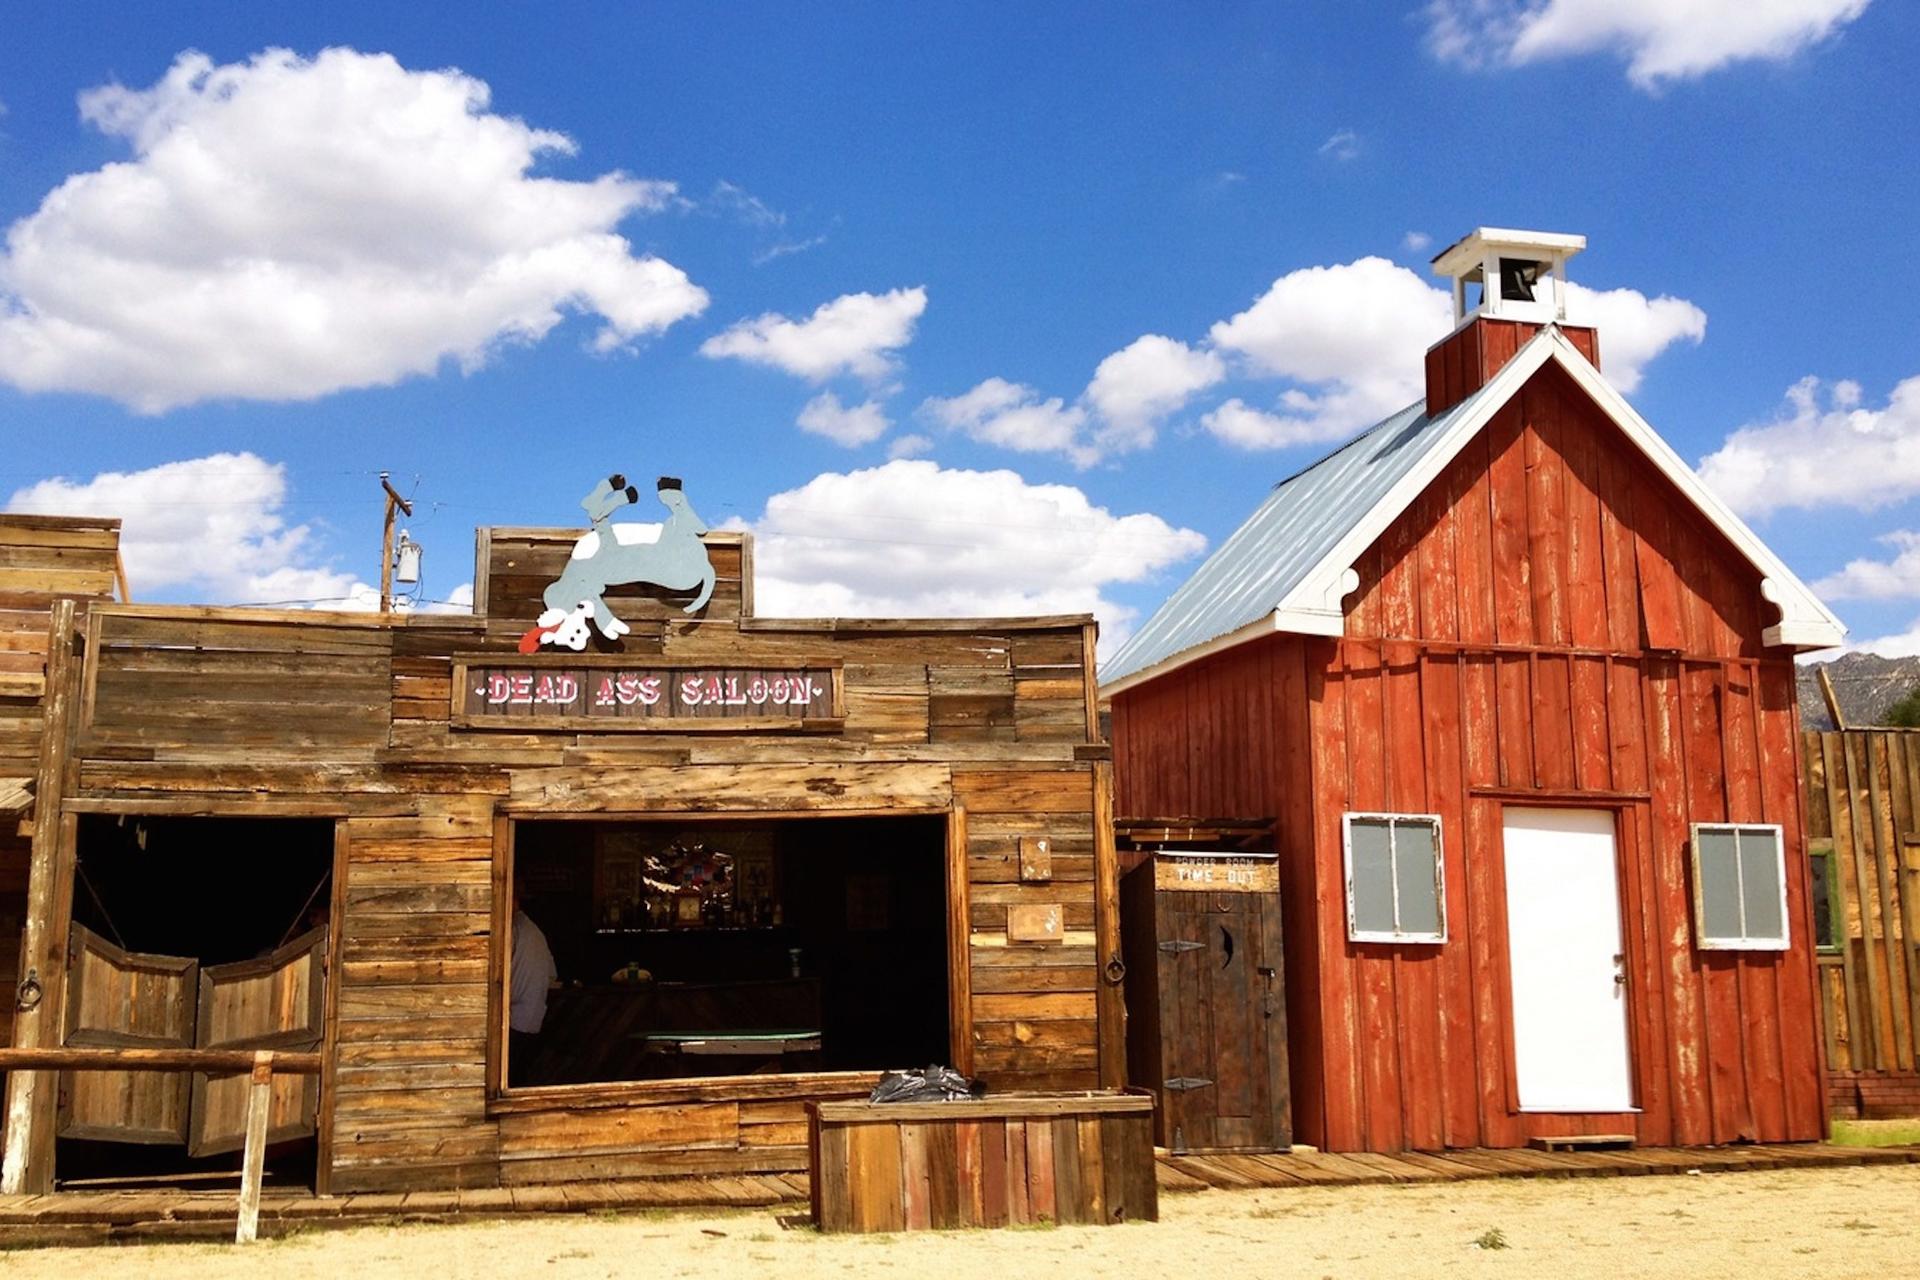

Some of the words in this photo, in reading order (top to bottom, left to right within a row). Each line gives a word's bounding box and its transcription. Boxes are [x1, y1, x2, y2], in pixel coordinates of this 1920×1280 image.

[487, 676, 579, 705] DEAD
[595, 676, 661, 706] ASS
[680, 677, 814, 706] SALOON
[1226, 870, 1257, 885] OUT
